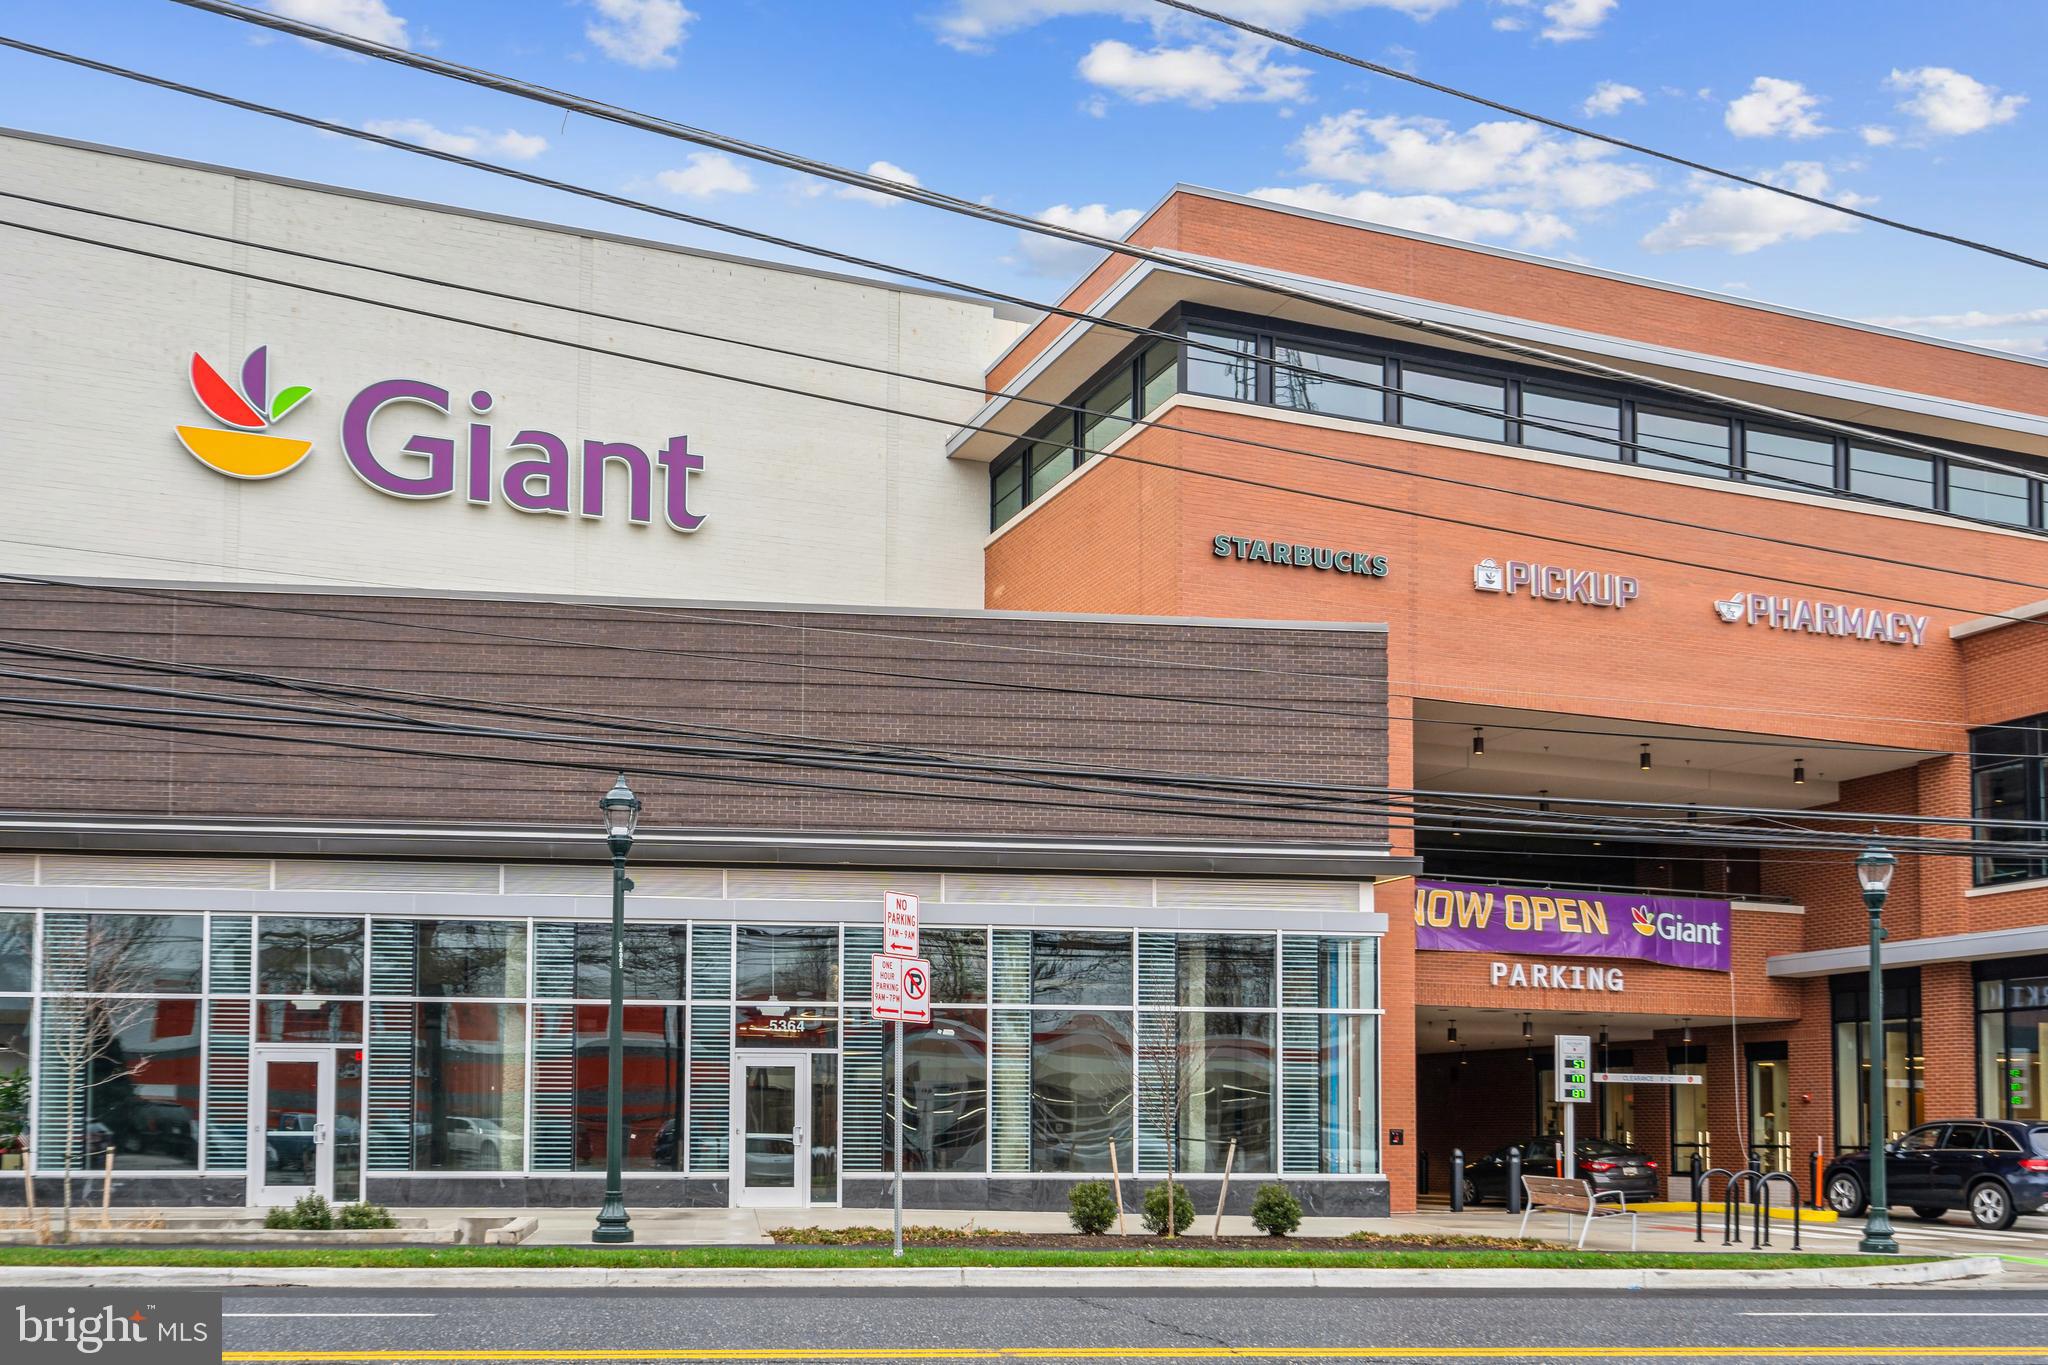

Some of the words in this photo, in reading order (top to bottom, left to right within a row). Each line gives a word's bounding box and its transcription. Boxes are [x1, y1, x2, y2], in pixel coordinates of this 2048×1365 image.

[340, 377, 709, 533] Giant
[1213, 534, 1389, 577] STARBUCKS
[1506, 560, 1639, 608] PICKUP
[1746, 593, 1929, 646] PHARMACY
[888, 912, 916, 927] PARKING
[896, 899, 908, 911] NO
[1504, 893, 1609, 935] OPEN
[1656, 912, 1724, 946] Giant
[880, 972, 895, 981] HOUR
[882, 961, 893, 970] ONE
[1490, 961, 1624, 992] PARKING
[876, 982, 899, 992] PARKING
[769, 1020, 805, 1032] 5364
